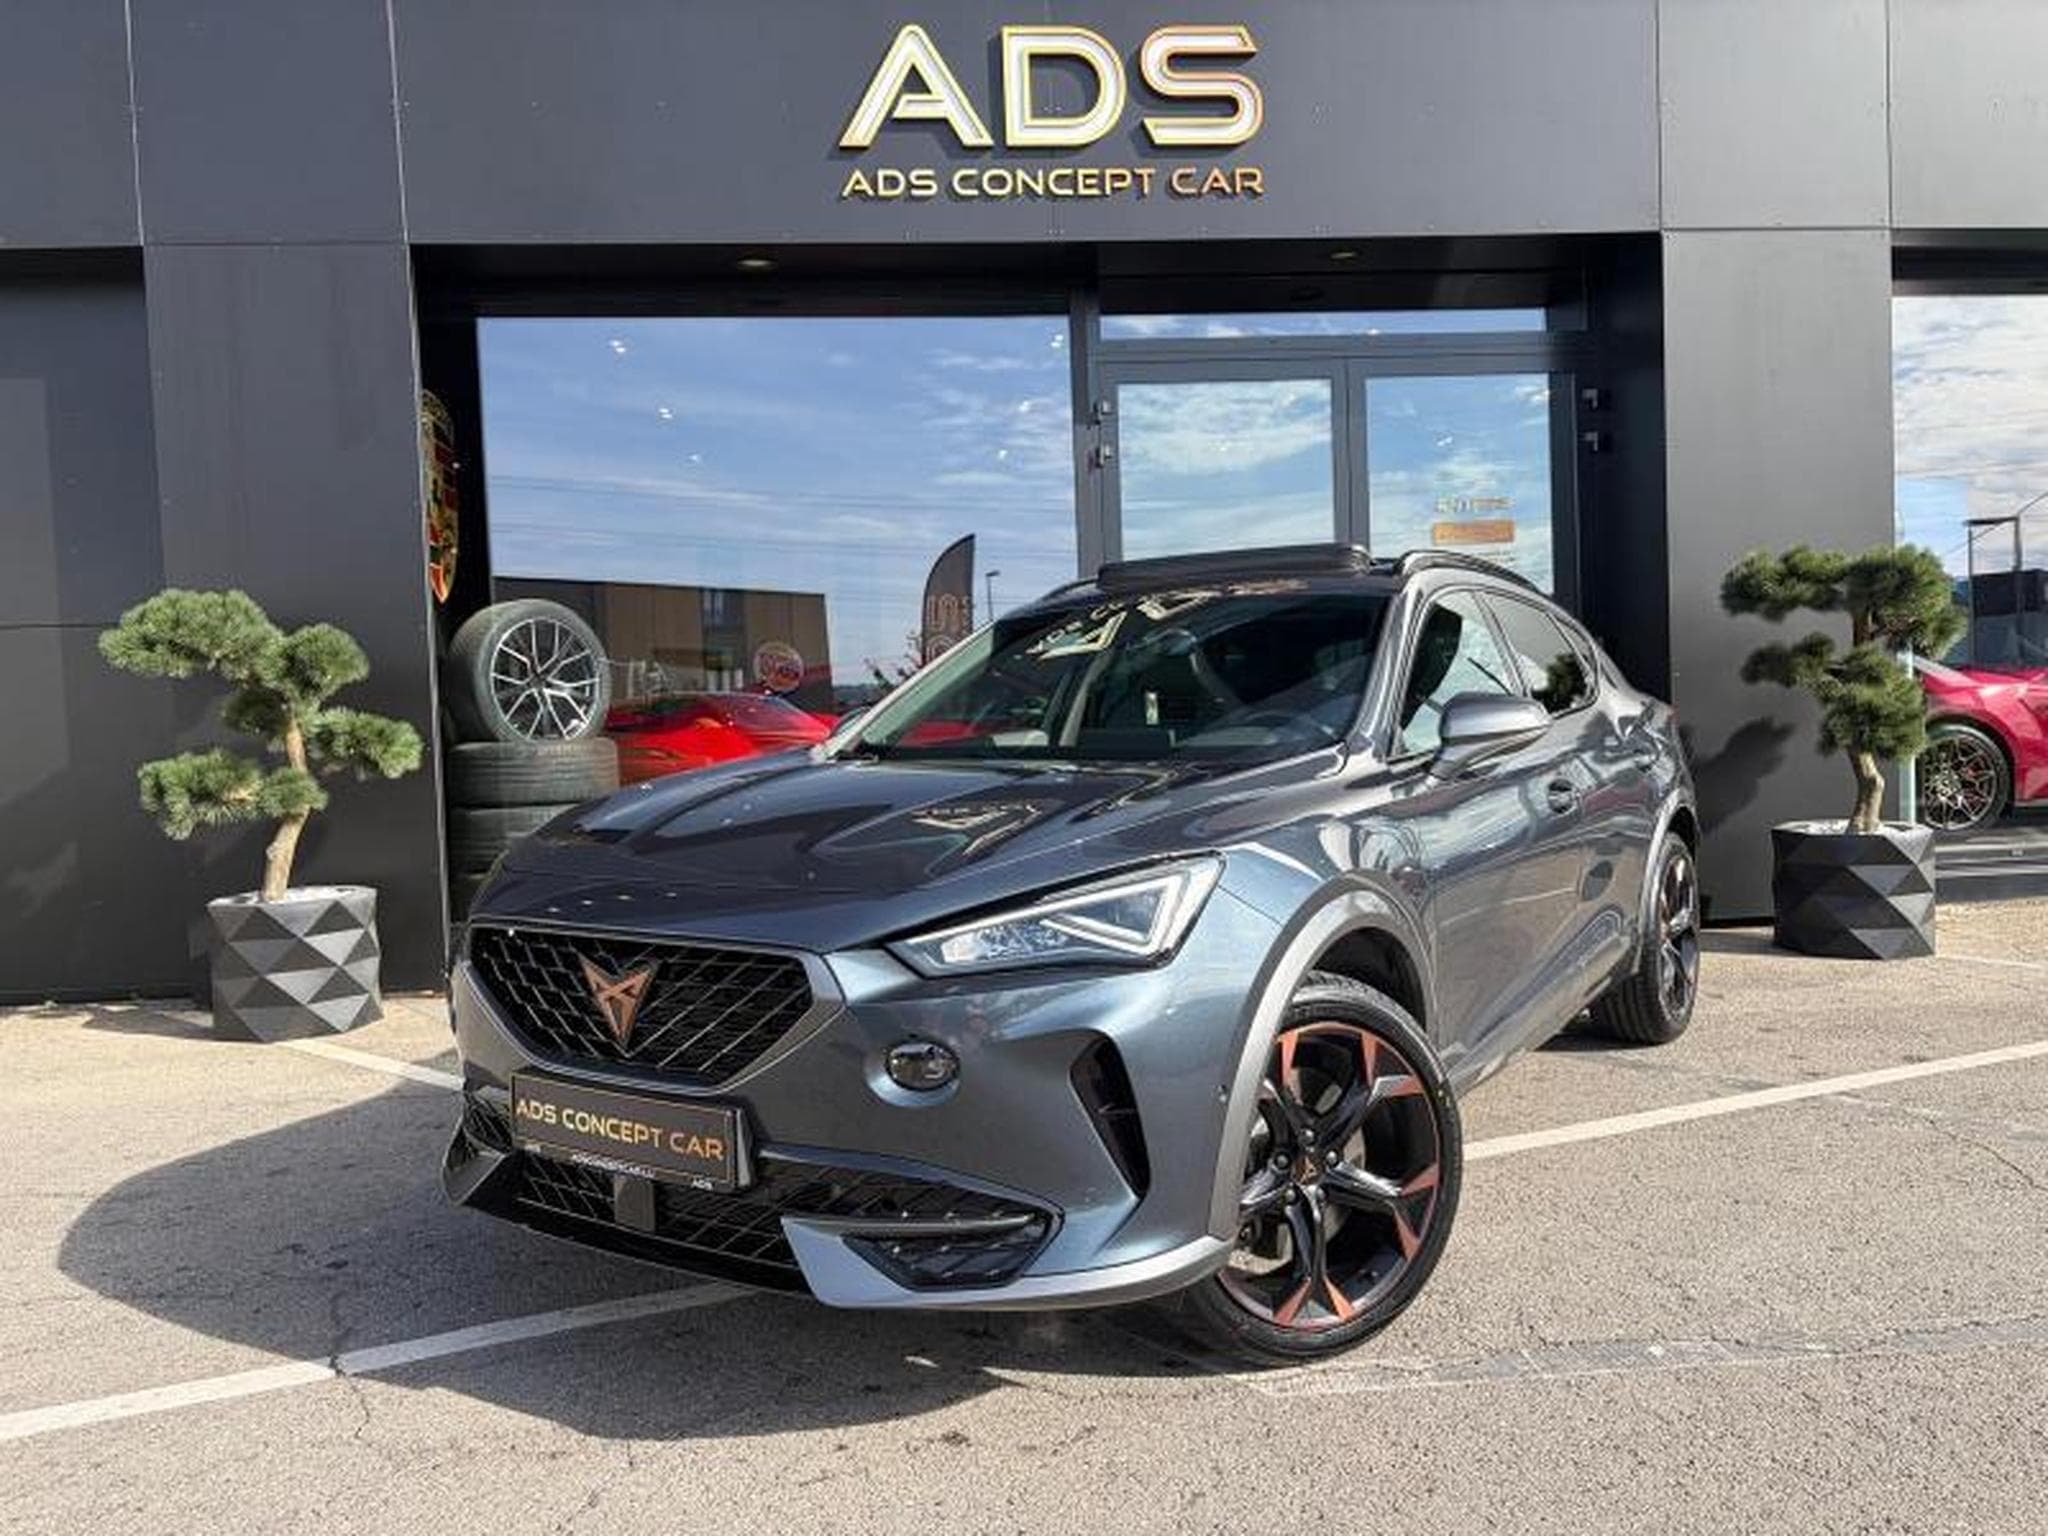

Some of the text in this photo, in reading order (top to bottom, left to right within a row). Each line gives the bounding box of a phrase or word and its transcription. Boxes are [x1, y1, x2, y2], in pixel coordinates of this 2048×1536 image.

[839, 24, 1263, 148] ADS
[842, 167, 1264, 197] ADS CONCEPT CAR
[516, 1099, 724, 1160] ADS CONCEPT CAR
